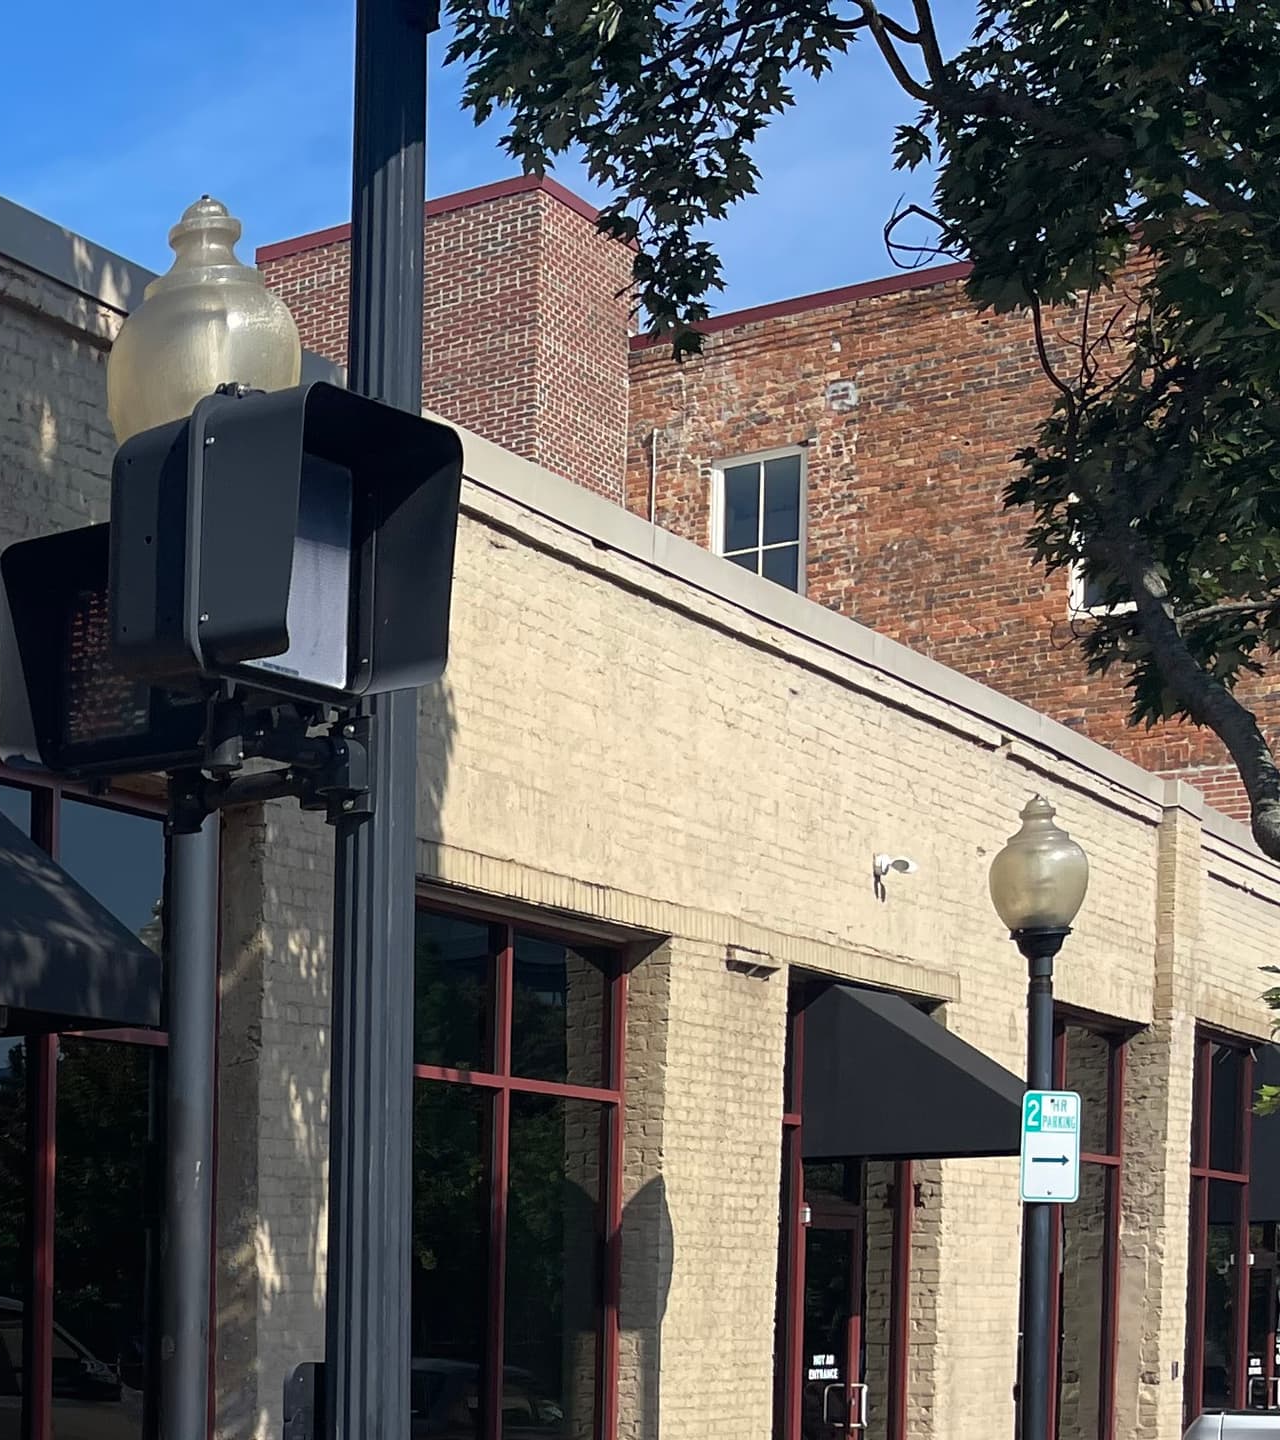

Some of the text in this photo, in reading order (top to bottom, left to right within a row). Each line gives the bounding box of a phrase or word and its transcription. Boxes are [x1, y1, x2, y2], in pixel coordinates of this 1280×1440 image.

[1052, 1099, 1067, 1112] HR
[1027, 1099, 1040, 1127] 2
[1042, 1115, 1076, 1129] PARKING
